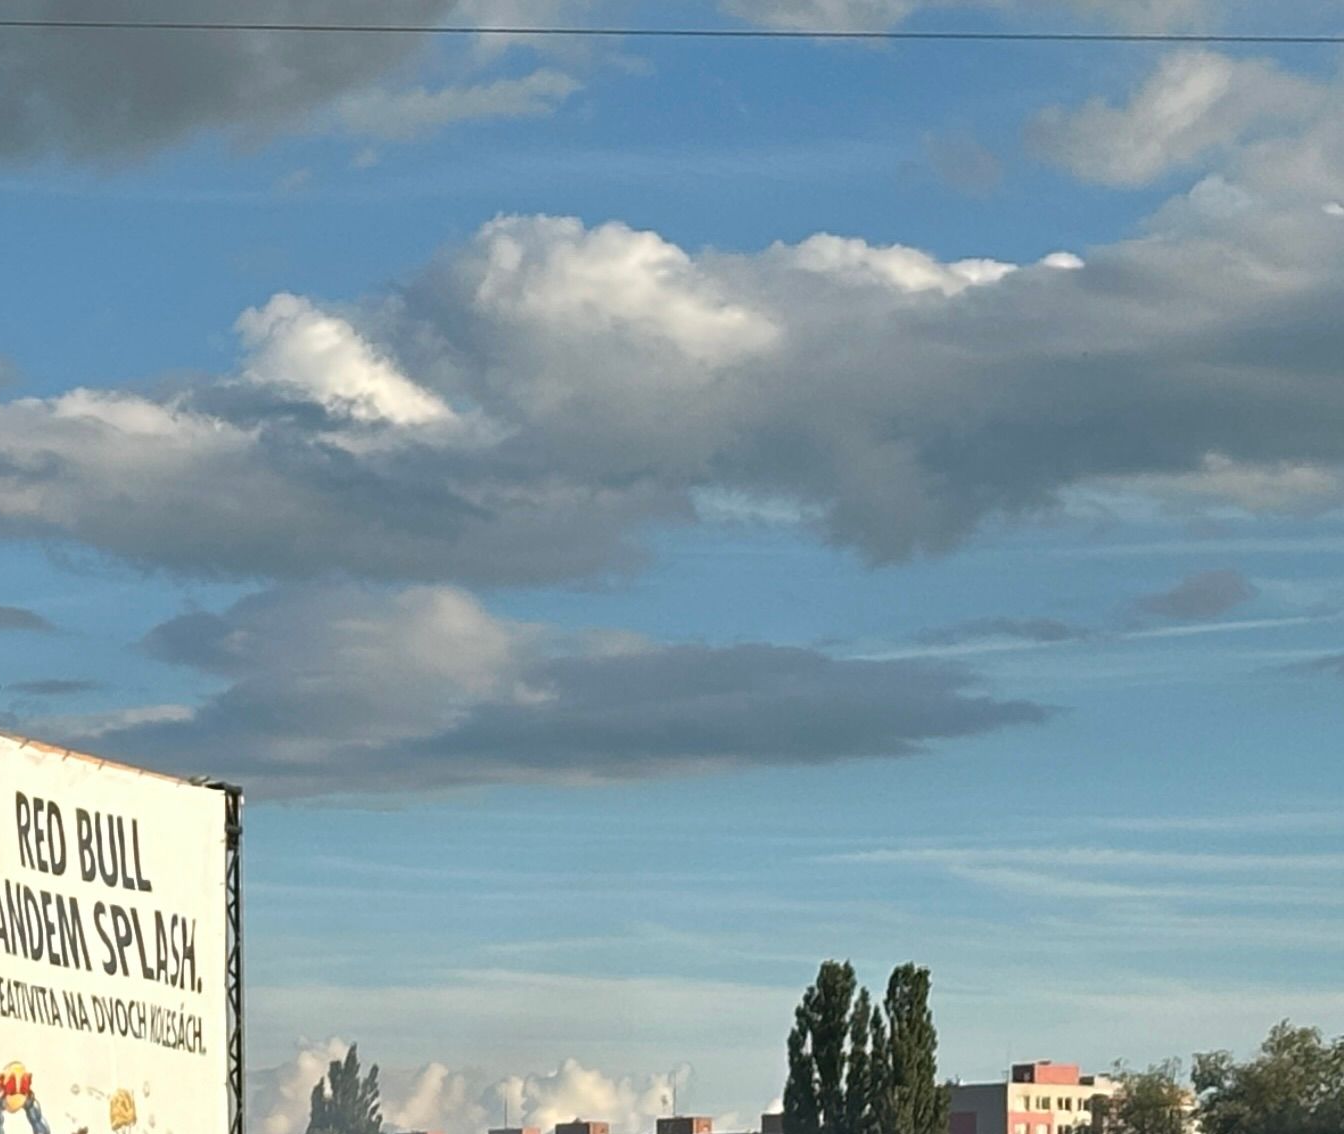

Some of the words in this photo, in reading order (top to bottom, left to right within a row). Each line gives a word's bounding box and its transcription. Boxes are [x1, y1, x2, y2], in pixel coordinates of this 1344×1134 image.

[16, 790, 66, 876] RED
[76, 808, 152, 892] BULL
[93, 901, 202, 993] SPLASH.
[62, 990, 92, 1032] NA
[92, 995, 146, 1039] DVOCH
